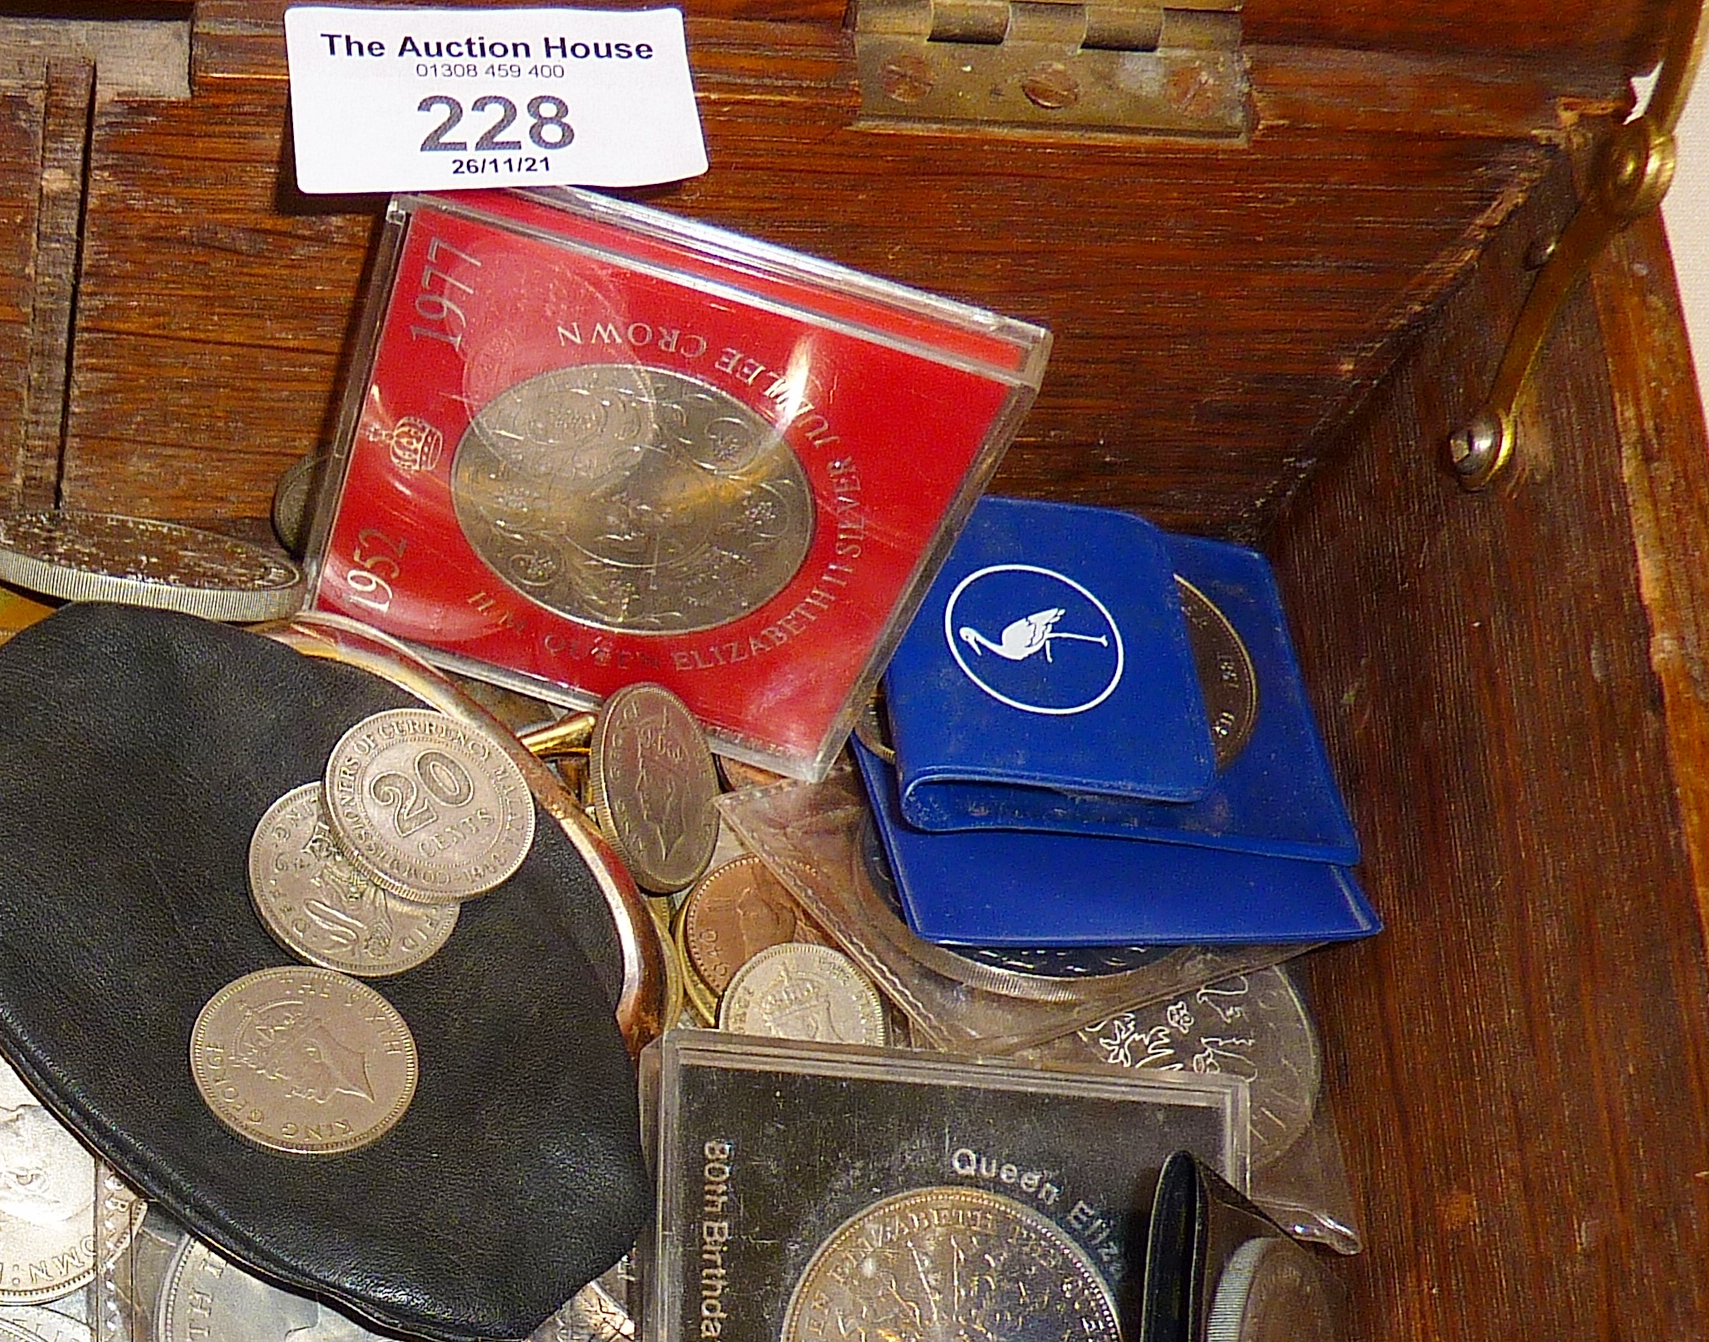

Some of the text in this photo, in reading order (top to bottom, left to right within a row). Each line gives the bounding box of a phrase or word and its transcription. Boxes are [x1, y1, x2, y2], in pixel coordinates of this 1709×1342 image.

[321, 33, 654, 60] The Auction House
[416, 63, 565, 79] 01308 459 400
[416, 94, 575, 152] 228
[451, 156, 551, 175] 26/11/21
[410, 236, 482, 353] 1977
[557, 321, 708, 358] CROWN
[826, 454, 867, 559] SILVER
[346, 528, 409, 613] 1952
[673, 585, 837, 672] ELIZABETH
[354, 734, 376, 755] OF
[378, 719, 490, 761] CURRENCY
[370, 749, 474, 837] 20
[419, 808, 493, 858] CENTS
[703, 1140, 730, 1215] 80th
[952, 1148, 1061, 1205] Queen
